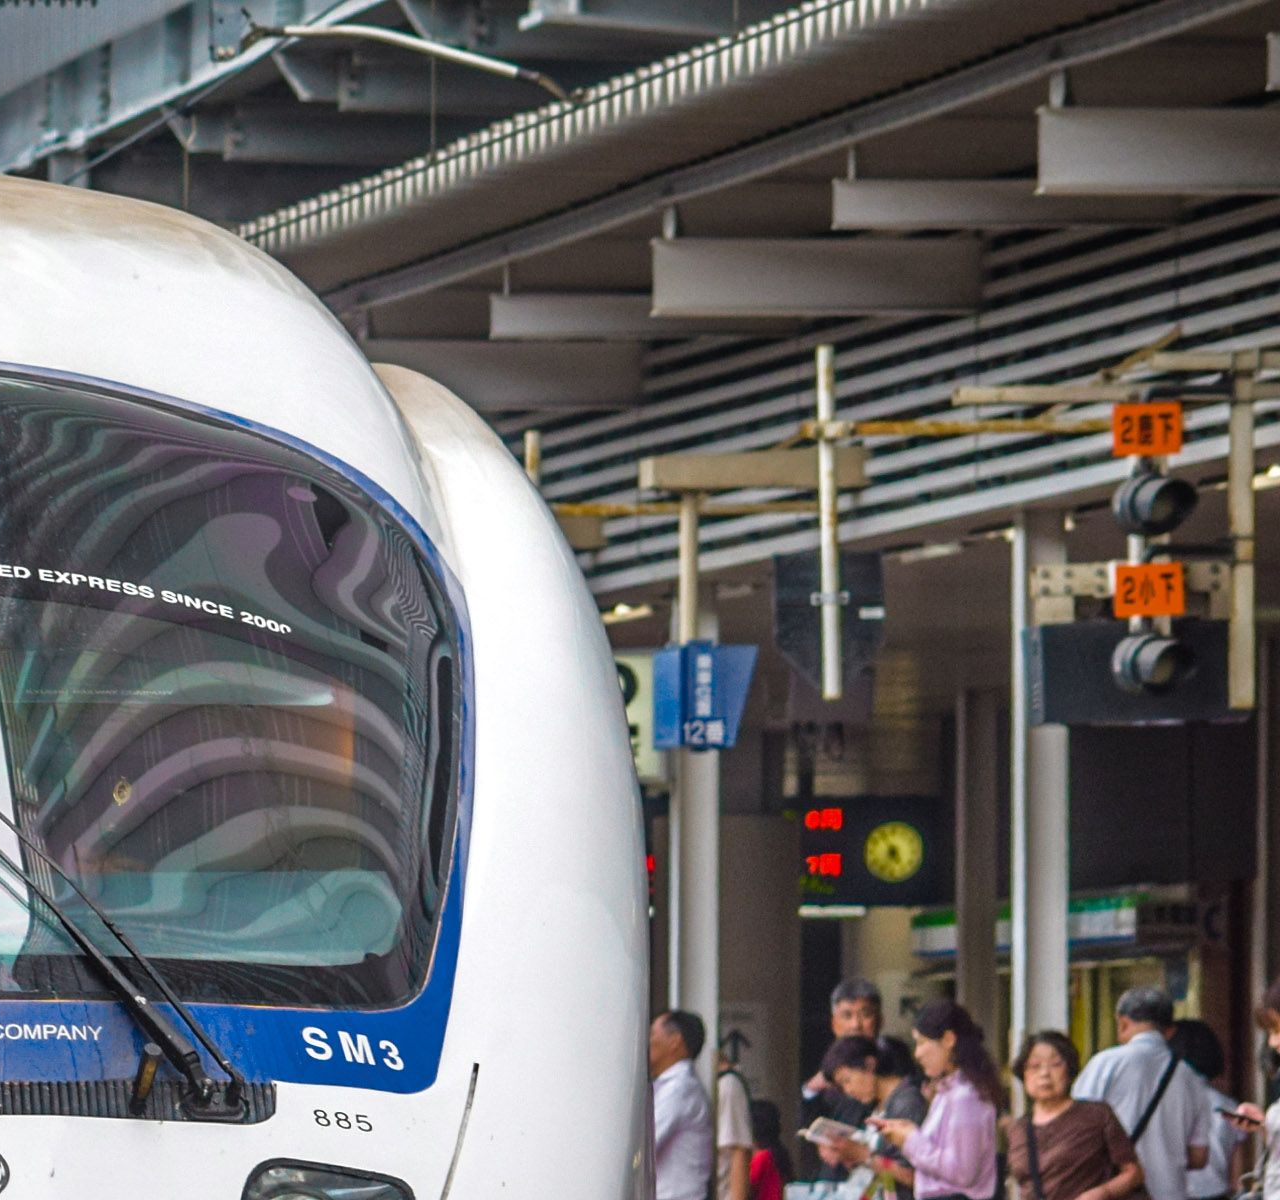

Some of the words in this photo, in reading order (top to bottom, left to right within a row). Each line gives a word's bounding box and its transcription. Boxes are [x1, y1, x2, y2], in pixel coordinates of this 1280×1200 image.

[38, 568, 155, 600] EXPRESS
[162, 589, 234, 619] SINCE
[301, 1026, 405, 1071] SM3
[313, 1109, 373, 1132] 885
